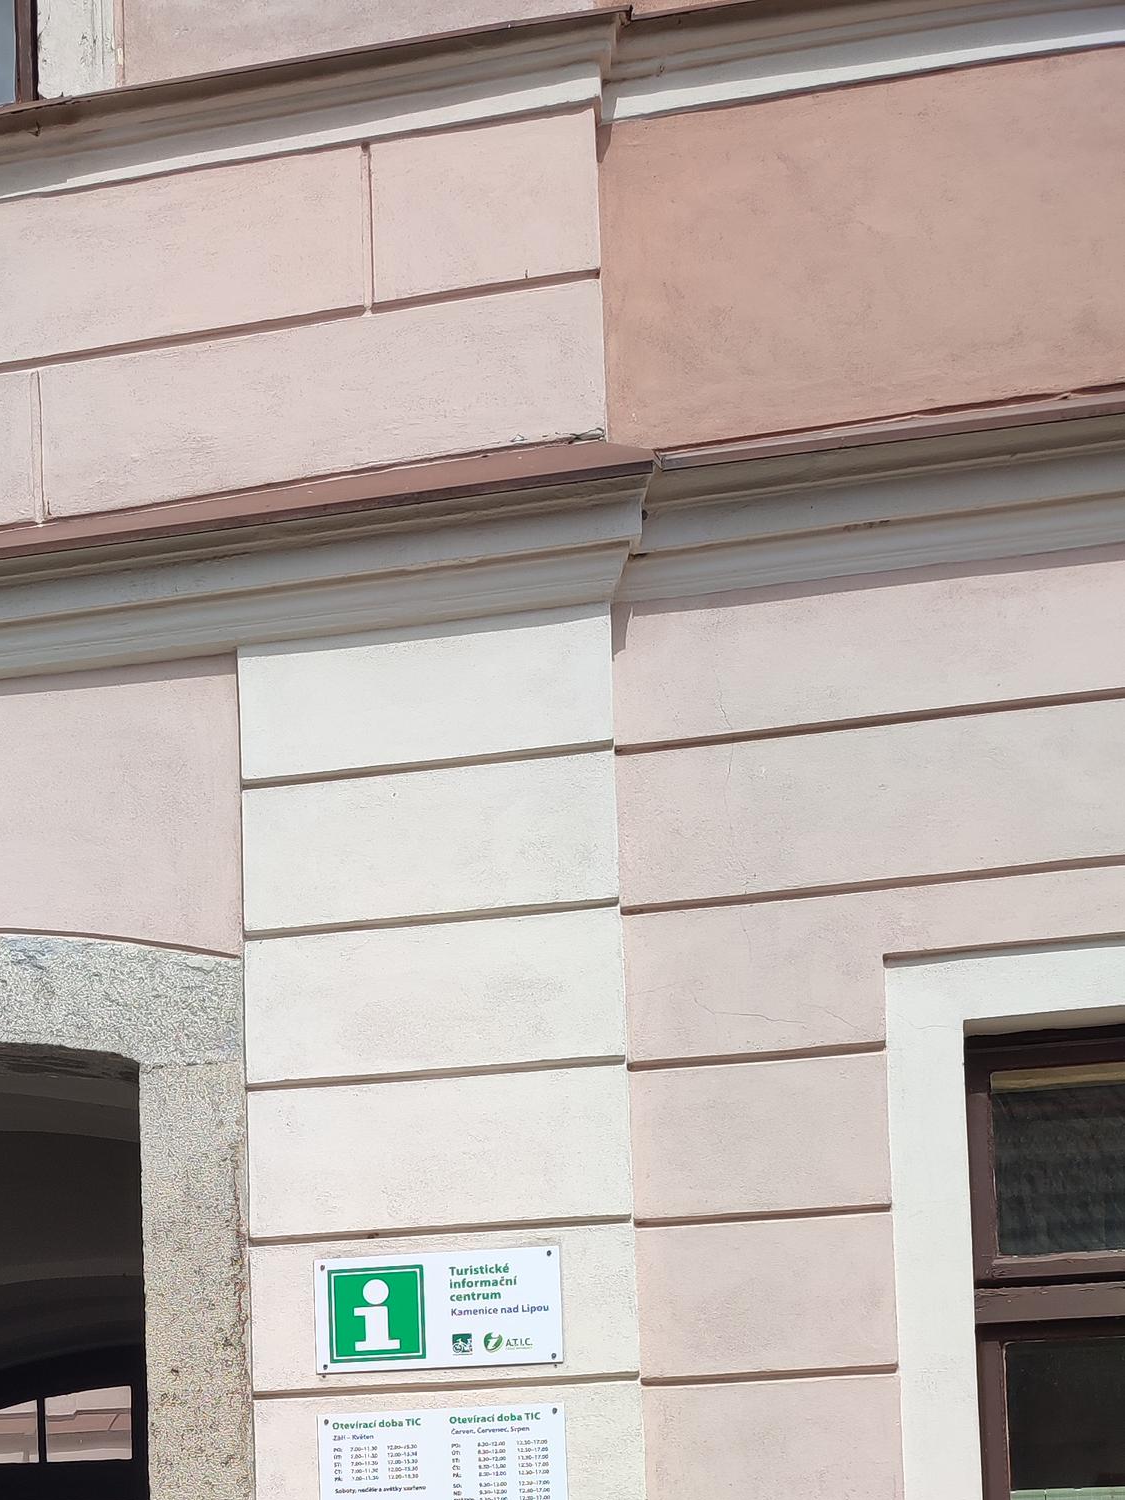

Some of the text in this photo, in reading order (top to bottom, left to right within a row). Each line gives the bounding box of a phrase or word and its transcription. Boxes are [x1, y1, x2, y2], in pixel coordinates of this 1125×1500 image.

[449, 1263, 509, 1275] Turistické
[449, 1276, 517, 1288] informační
[450, 1292, 501, 1301] centrum
[451, 1304, 549, 1316] Kamenice nad Lipou
[332, 1418, 421, 1429] Otevírací doba TIC
[449, 1412, 541, 1424] Otevírací doba TIC
